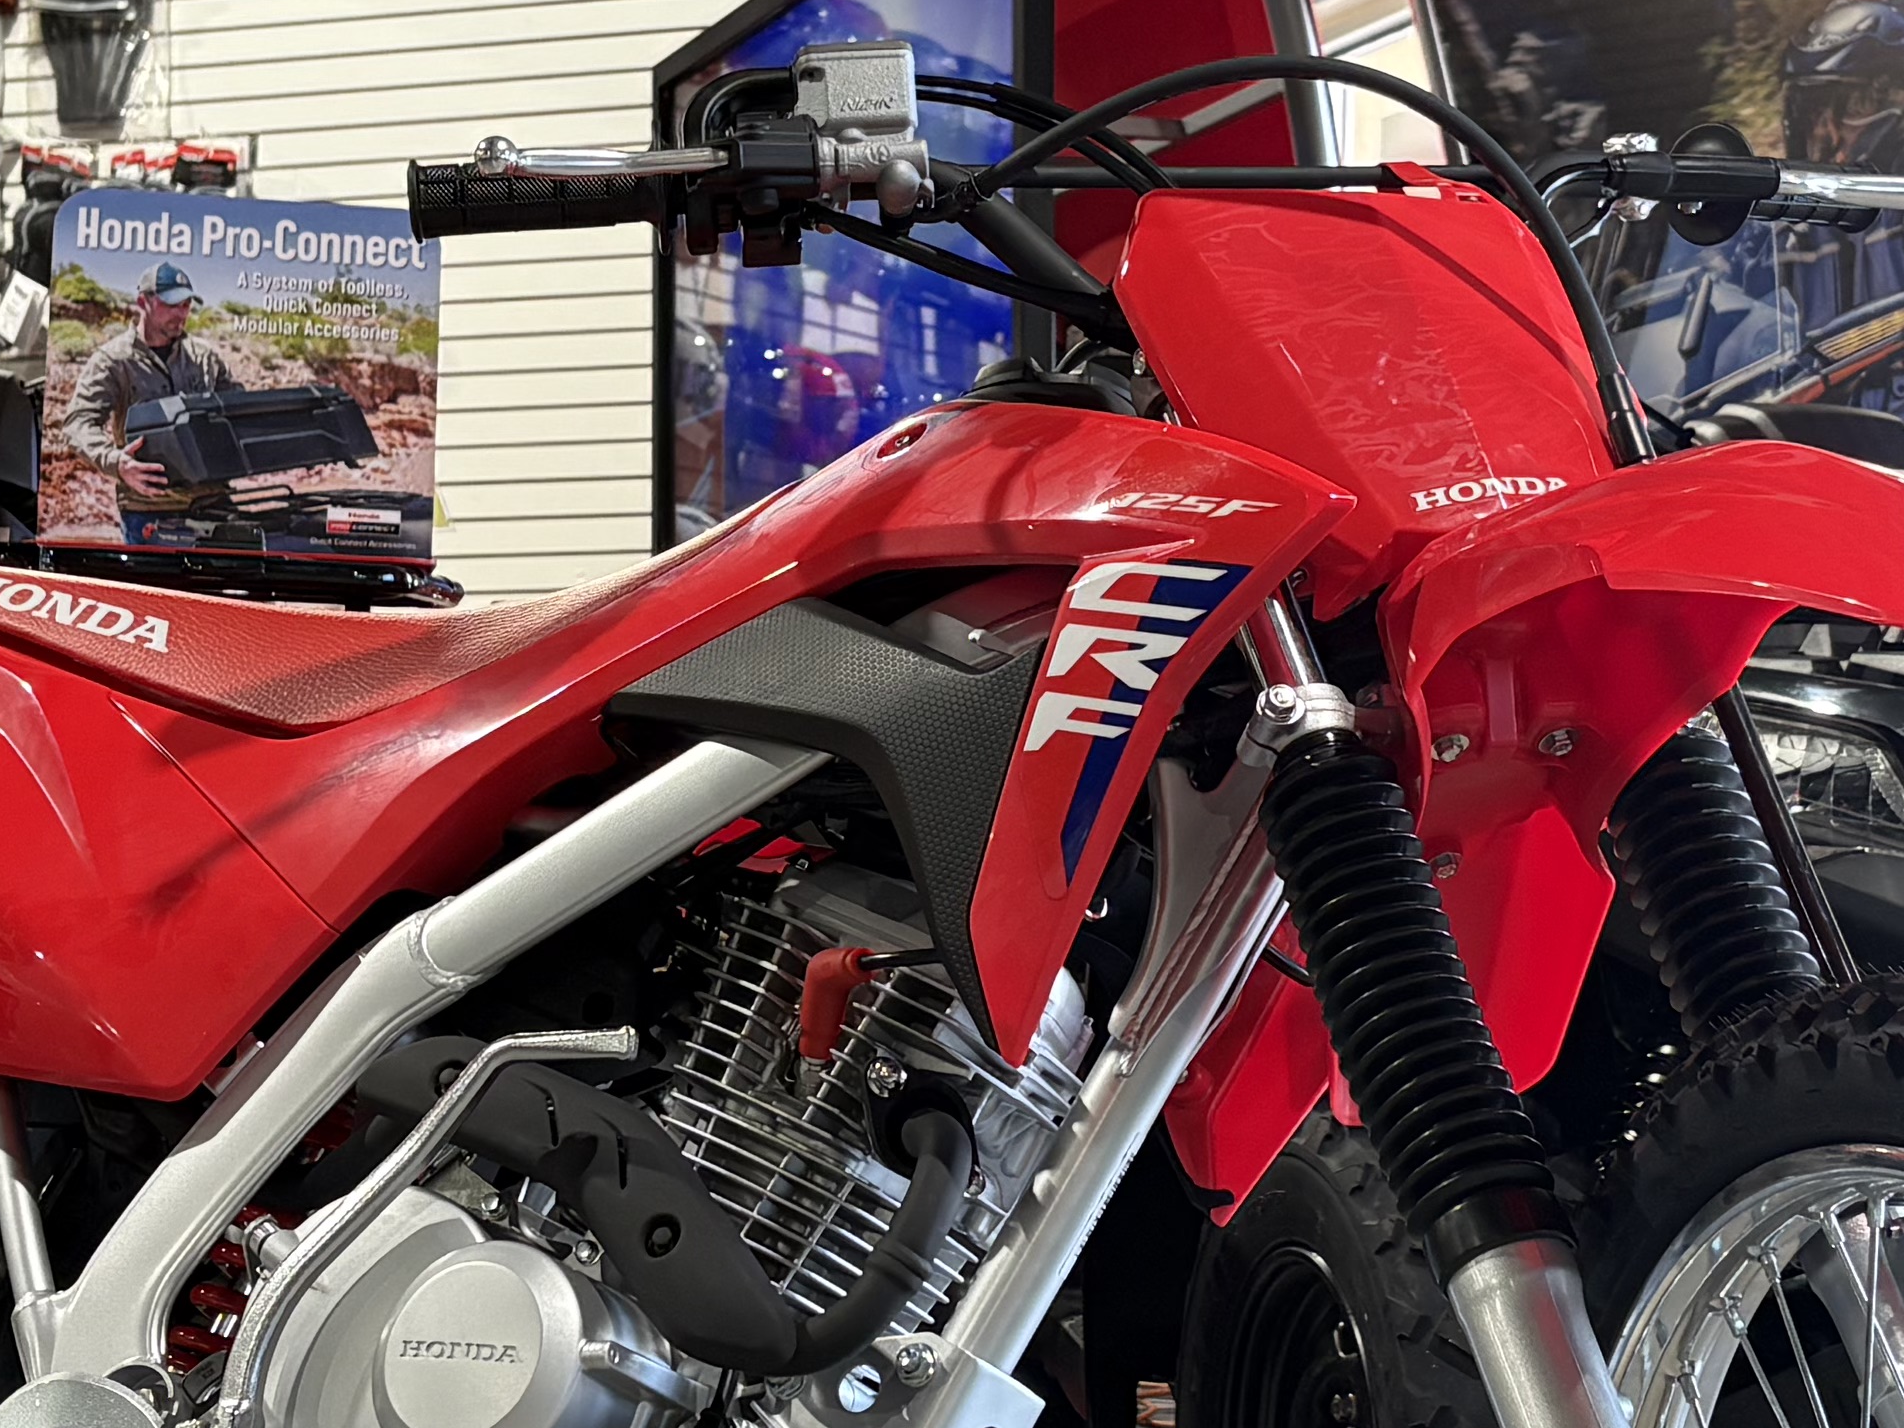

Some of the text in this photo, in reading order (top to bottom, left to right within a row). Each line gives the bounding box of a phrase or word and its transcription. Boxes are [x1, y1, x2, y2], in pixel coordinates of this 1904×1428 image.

[76, 206, 428, 270] Honda Pro-Connect
[236, 271, 410, 300] A System of Toolless,
[263, 294, 378, 319] Quick Connect
[233, 315, 405, 342] Modular Accessories.
[1112, 492, 1283, 519] 125F
[1410, 477, 1568, 512] HONDA
[1022, 561, 1229, 752] CRF
[399, 1339, 524, 1364] HONDA
